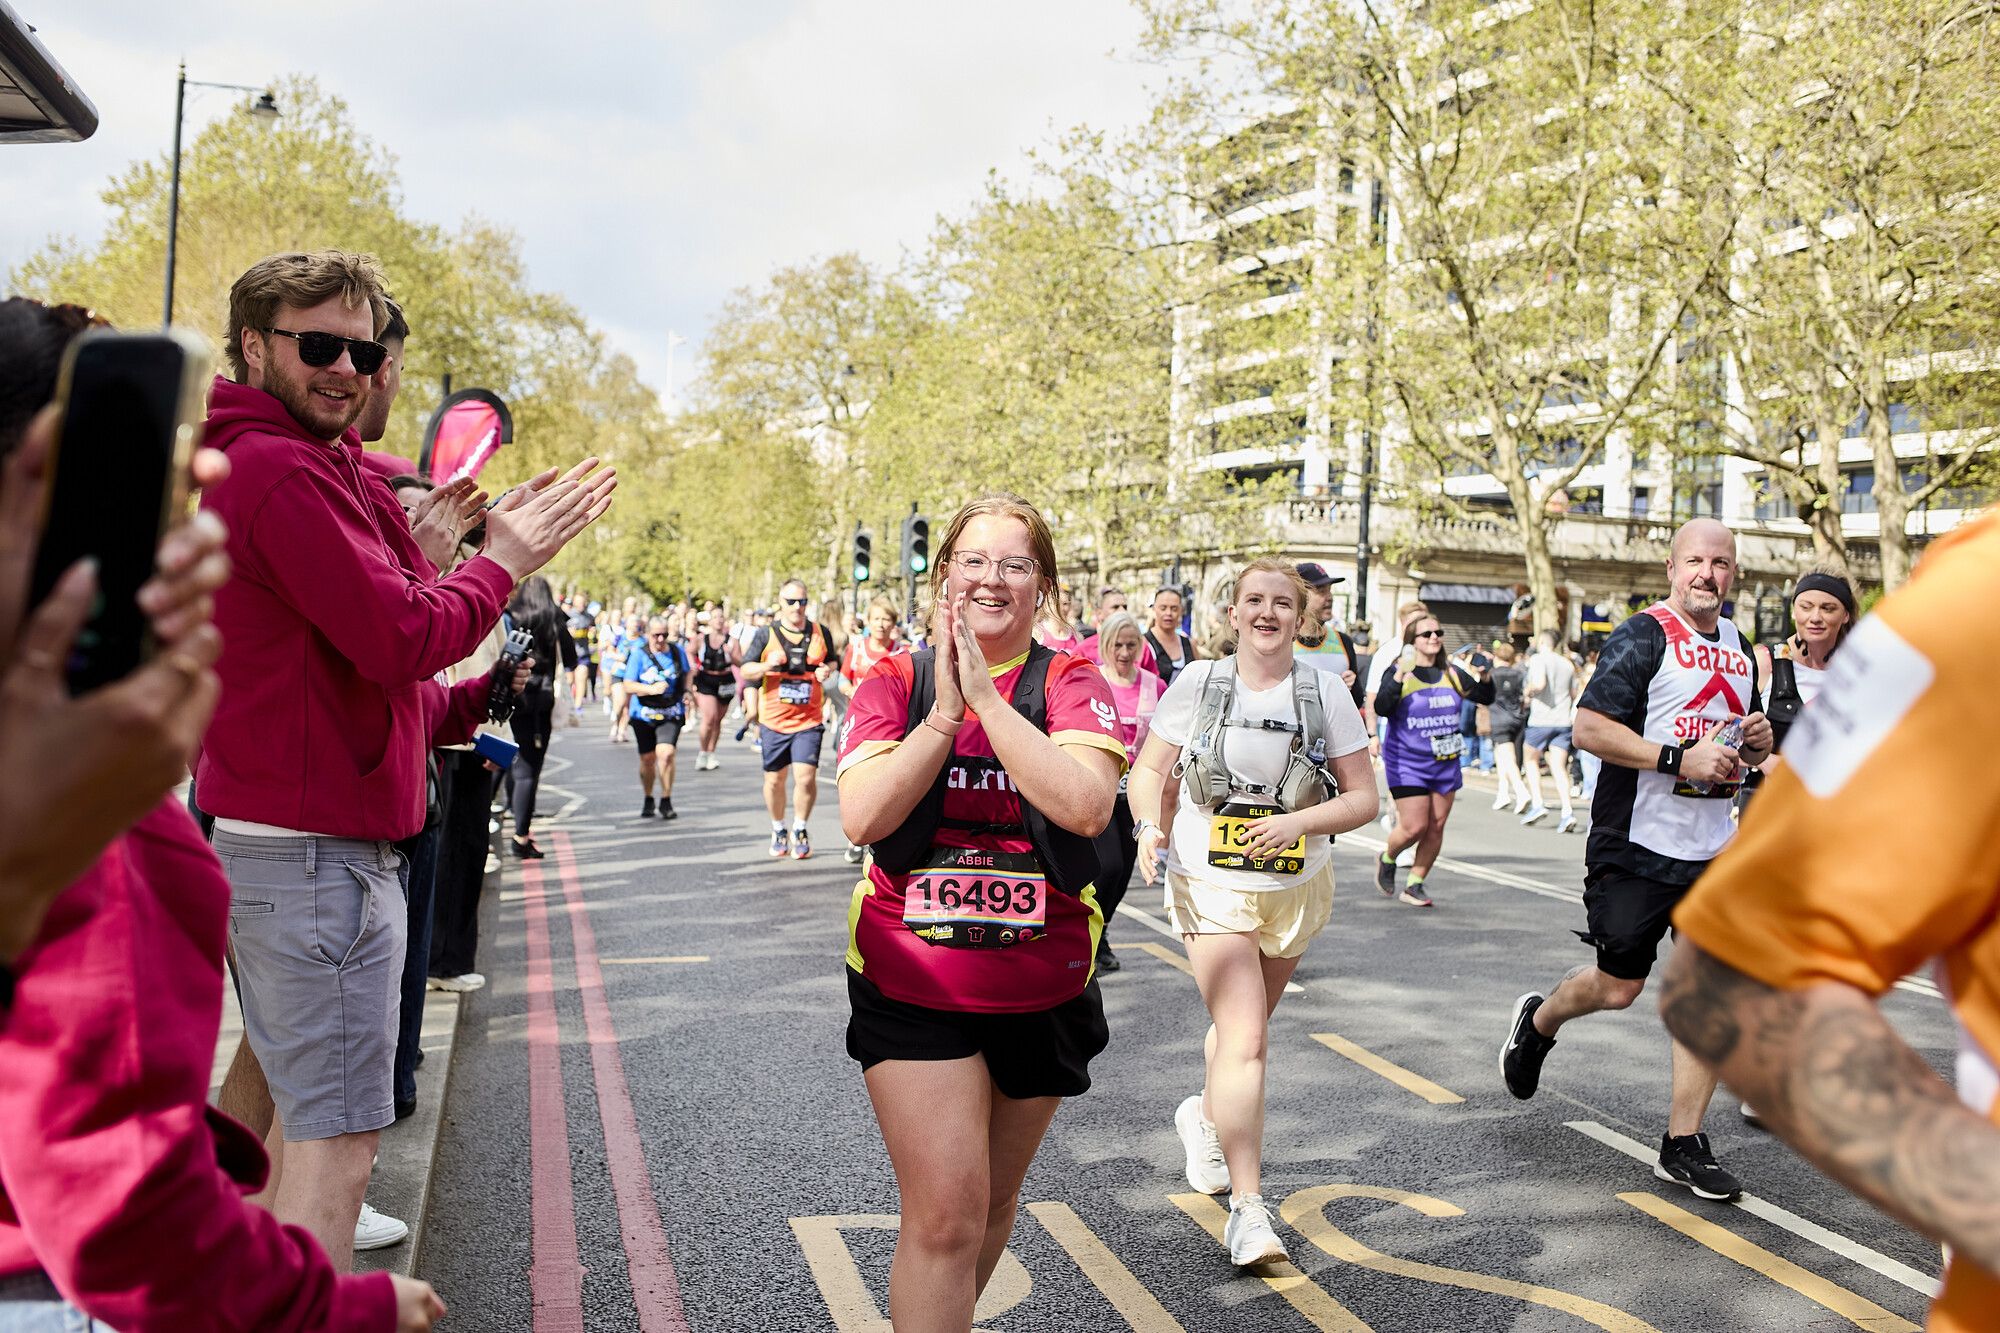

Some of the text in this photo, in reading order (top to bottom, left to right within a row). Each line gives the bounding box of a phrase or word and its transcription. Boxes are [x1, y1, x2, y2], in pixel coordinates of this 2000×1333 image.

[1674, 639, 1748, 677] Gazza
[1249, 808, 1273, 817] ELLIE
[957, 855, 994, 866] ABBIE
[916, 878, 1037, 915] 16493
